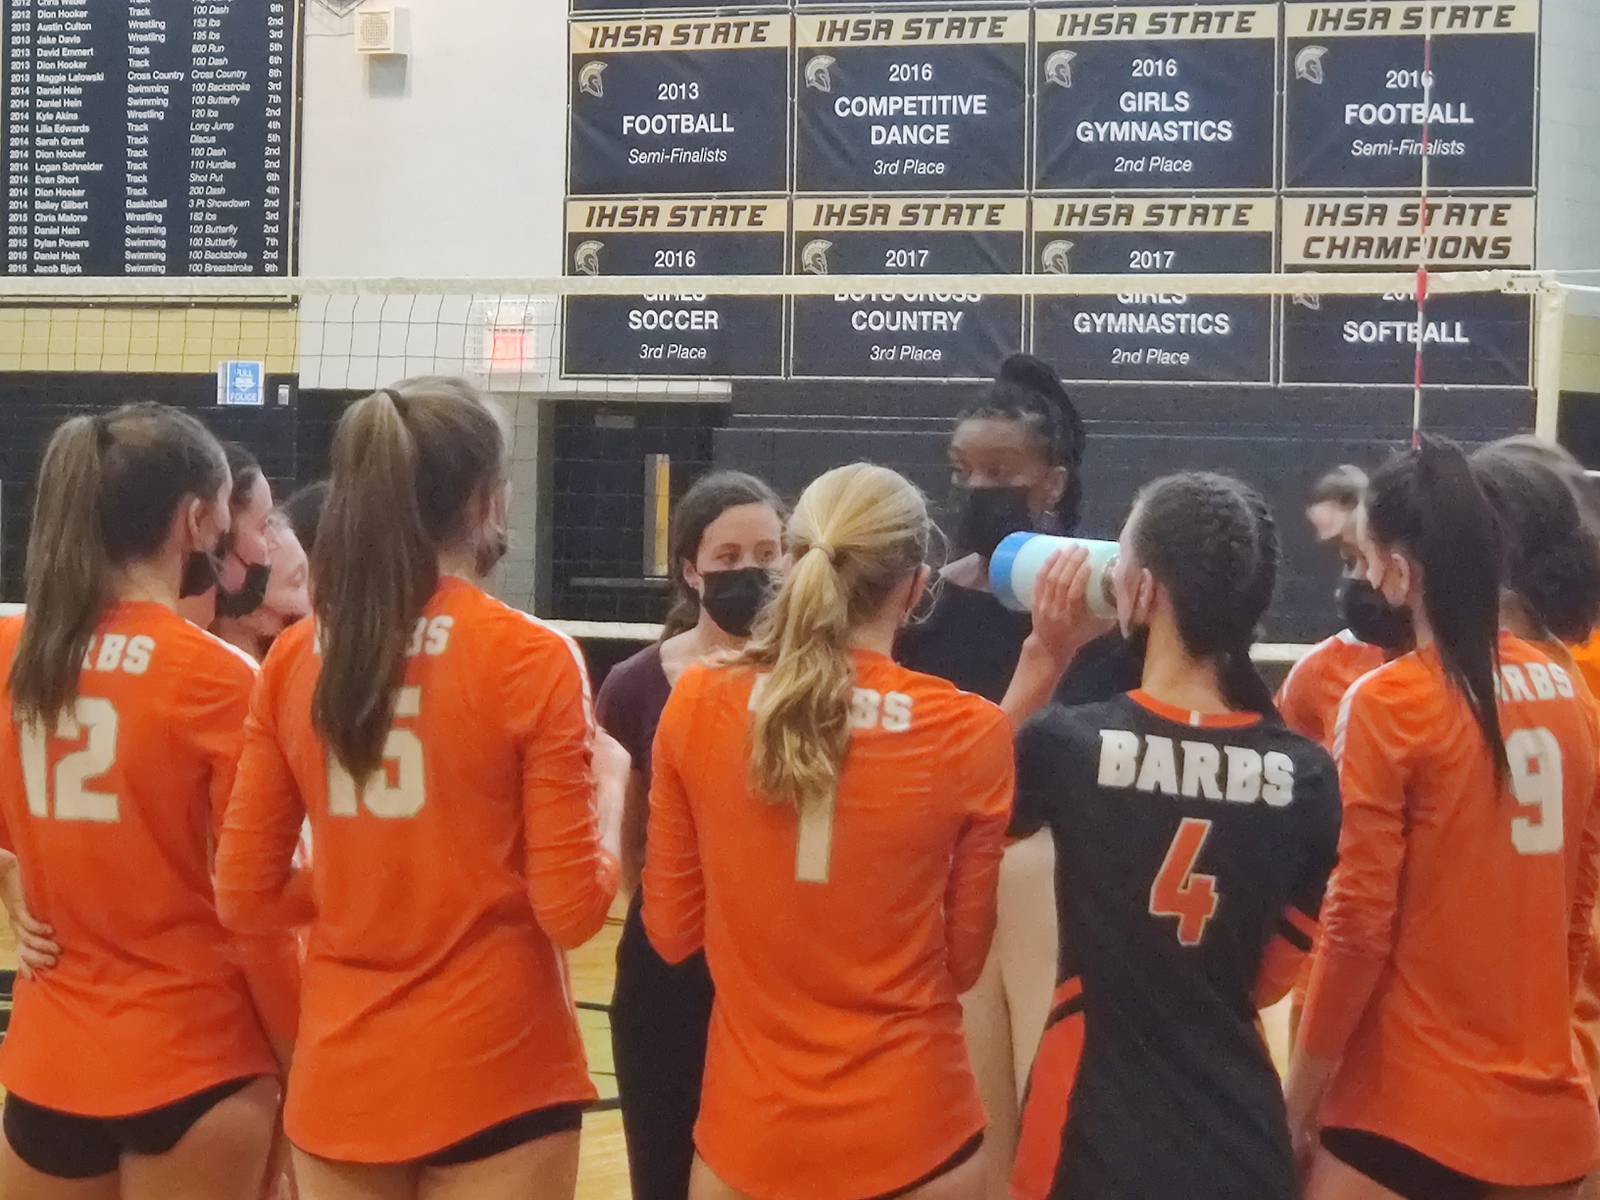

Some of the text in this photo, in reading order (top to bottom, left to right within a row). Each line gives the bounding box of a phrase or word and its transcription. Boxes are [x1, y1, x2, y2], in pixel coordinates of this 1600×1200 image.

[816, 16, 1006, 42] IHSA STATE
[1056, 11, 1255, 36] IHSA STATE
[1307, 5, 1515, 32] IHSA STATE
[589, 21, 770, 48] IHSA STATE
[889, 64, 932, 82] 2016
[1132, 59, 1176, 77] 2016
[1386, 70, 1433, 88] 2016
[658, 83, 699, 100] 2013
[1119, 91, 1190, 112] GIRLS
[834, 94, 987, 118] COMPETITIVE
[1345, 103, 1474, 124] FOOTBALL
[622, 114, 734, 136] FOOTBALL
[871, 124, 949, 146] DANCE
[1076, 120, 1233, 142] GYMNASTICS
[628, 147, 727, 164] Semi-Finalists
[1351, 140, 1465, 156] Semi-Finalists
[873, 159, 945, 176] 3rd Place
[1114, 157, 1192, 173] 2nd Place
[585, 205, 766, 228] IHSA STATE
[813, 204, 1004, 226] IHSA STATE
[1054, 204, 1253, 228] IHSA STATE
[1304, 203, 1511, 226] IHSA STATE
[655, 250, 696, 268] 2016
[885, 250, 928, 268] 2017
[1303, 236, 1512, 260] CHAMPIONS
[1130, 250, 1174, 269] 2017
[628, 310, 719, 330] SOCCER
[852, 310, 963, 331] COUNTRY
[1074, 312, 1230, 334] GYMNASTICS
[1343, 320, 1470, 343] SOFTBALL
[640, 344, 707, 359] 3rd Place
[870, 346, 942, 360] 3rd Place
[1112, 348, 1190, 364] 2nd Place
[1493, 662, 1575, 702] RBS
[19, 697, 119, 823] 12
[1097, 729, 1295, 807] BARBS
[1505, 726, 1565, 856] 9
[1149, 817, 1219, 948] 4
